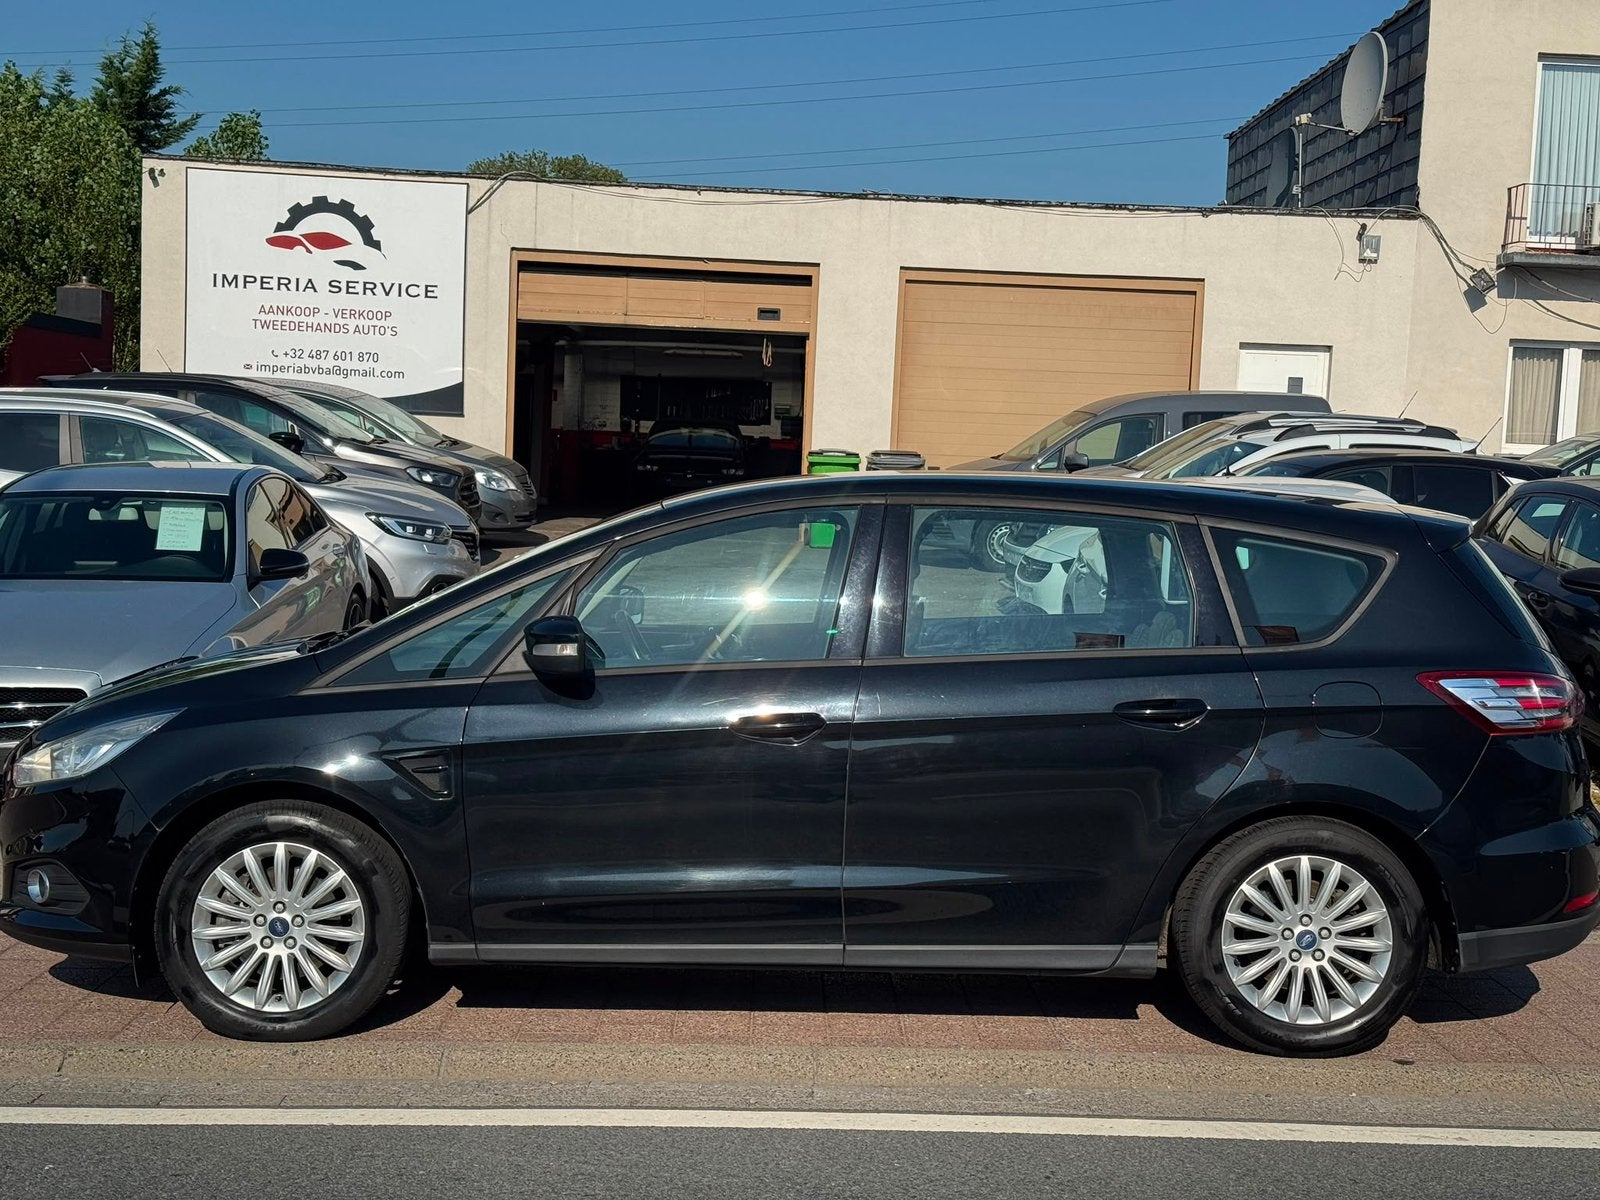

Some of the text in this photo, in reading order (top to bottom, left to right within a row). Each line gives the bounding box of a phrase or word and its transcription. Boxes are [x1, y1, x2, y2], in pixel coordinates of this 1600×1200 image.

[212, 272, 439, 300] IMPERIA SERVICE
[257, 303, 321, 318] AANKOOP
[332, 307, 393, 322] VERKOOP
[251, 318, 398, 337] TWEEDEHANDS AUTO'S
[282, 347, 380, 364] +32 487 601 870
[255, 362, 406, 380] imperiabvba@gmail.com
